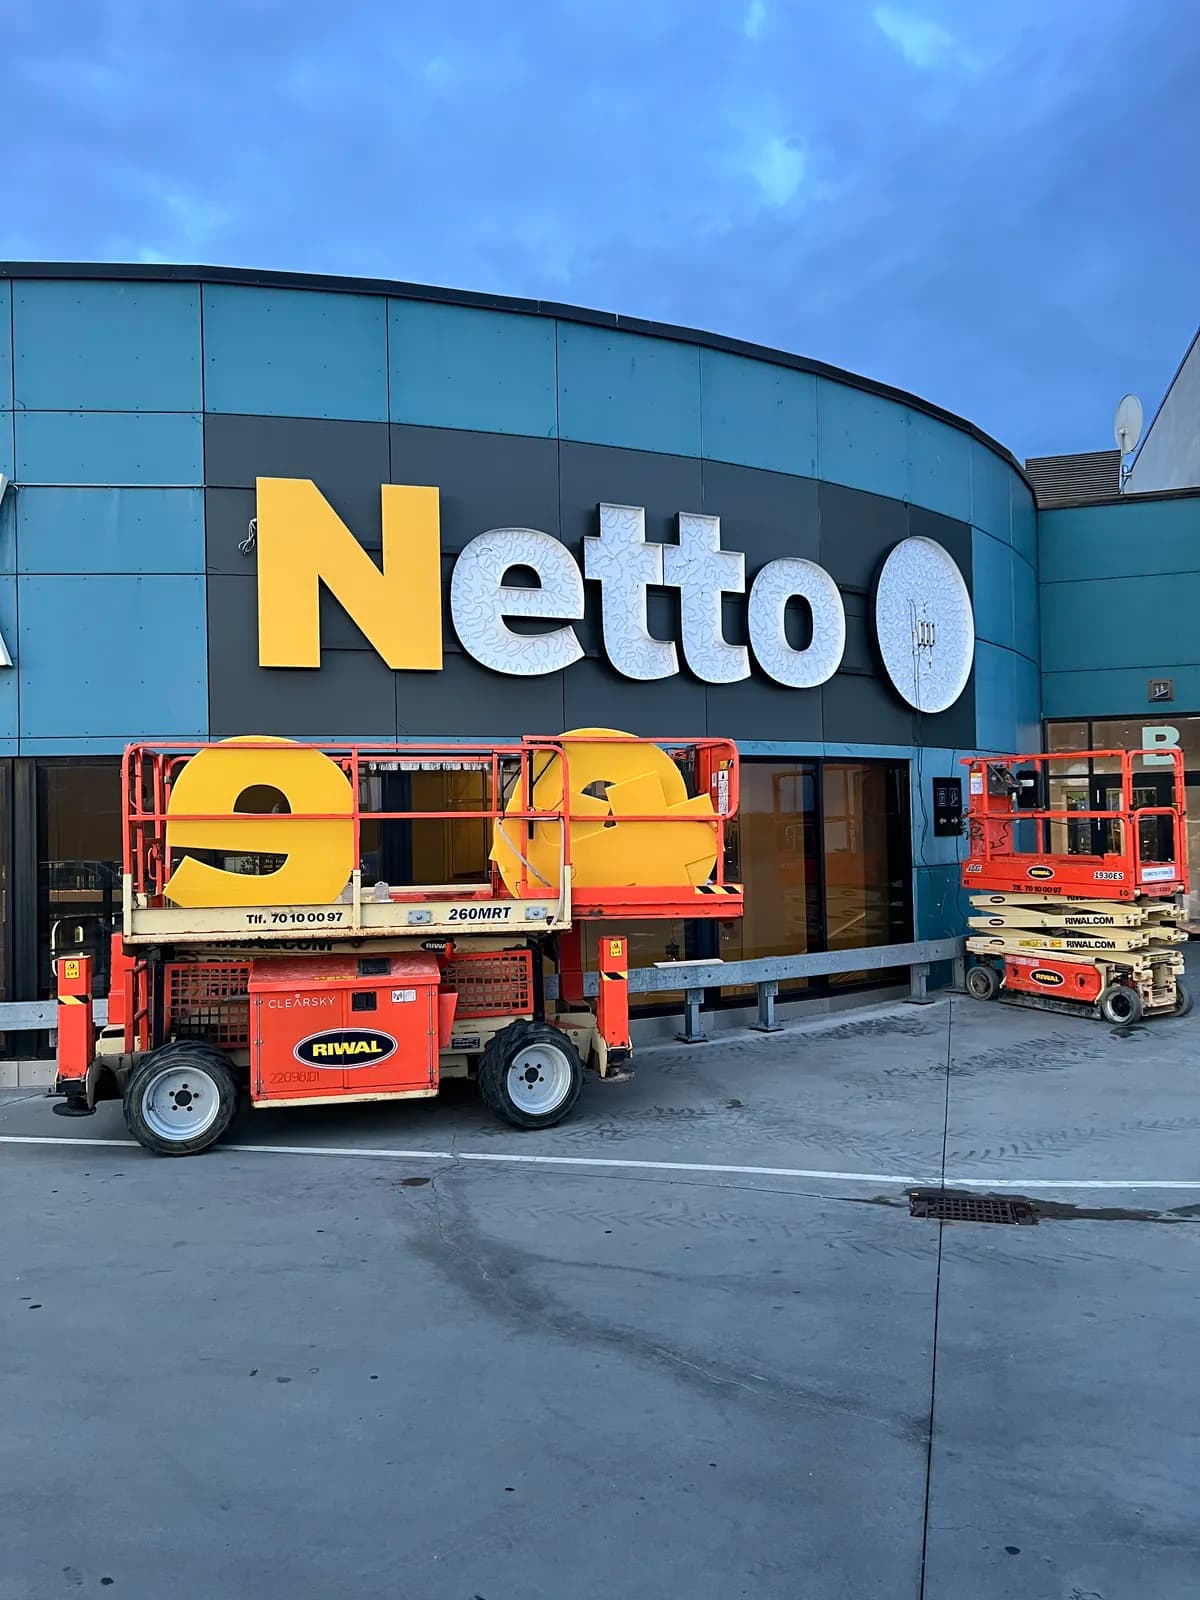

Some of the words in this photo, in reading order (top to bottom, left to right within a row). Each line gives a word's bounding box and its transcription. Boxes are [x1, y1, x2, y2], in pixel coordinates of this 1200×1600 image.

[256, 476, 846, 688] Netto
[1142, 726, 1182, 765] B
[1095, 871, 1123, 880] 1930ES
[246, 914, 267, 924] Tlf.
[449, 907, 511, 920] 260MRT
[1035, 973, 1060, 982] RIWAL
[268, 995, 336, 1009] CLEARSKY
[312, 1040, 383, 1057] RIWAL
